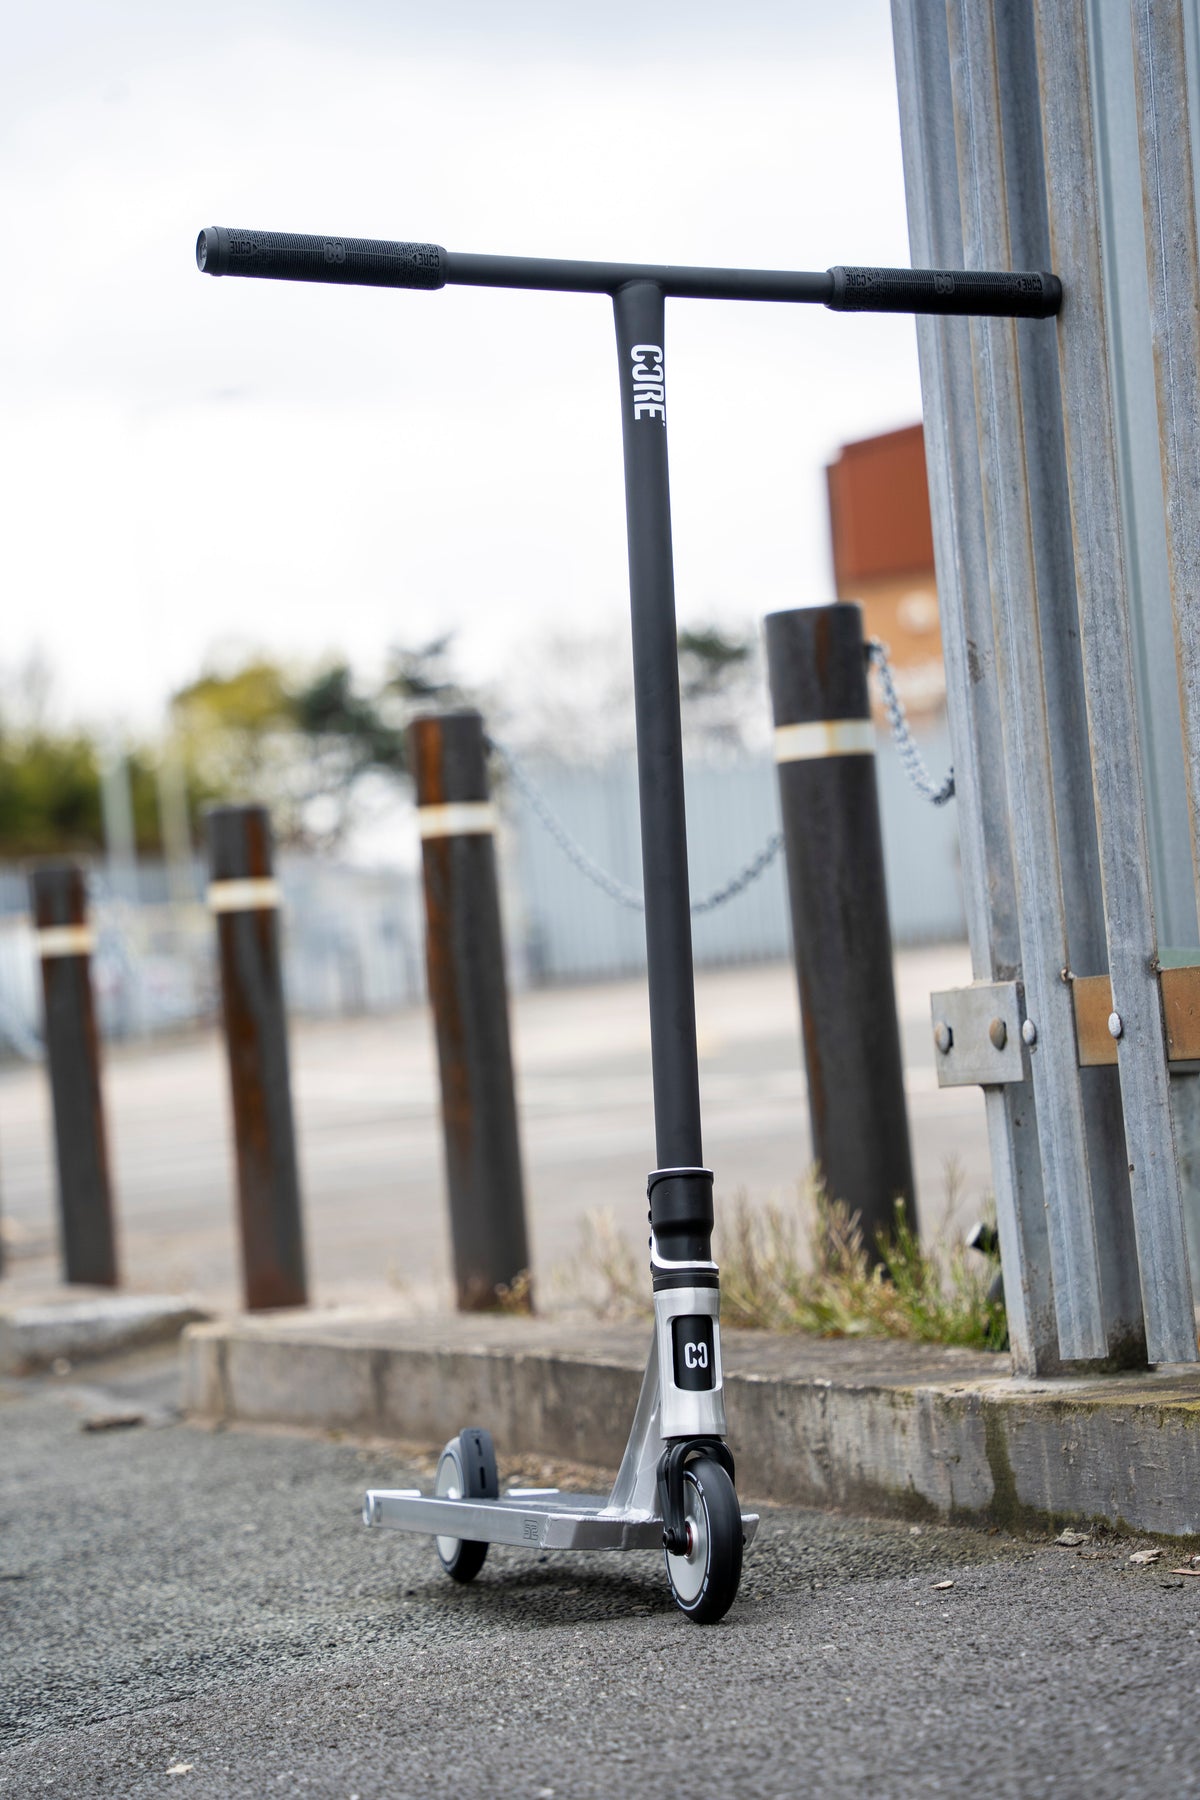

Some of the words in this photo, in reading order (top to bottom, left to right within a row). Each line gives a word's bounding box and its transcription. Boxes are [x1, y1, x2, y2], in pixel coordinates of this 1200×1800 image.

[418, 252, 439, 268] CORE
[846, 273, 867, 287] CORE
[1021, 278, 1043, 292] CORE
[631, 344, 666, 421] CORE
